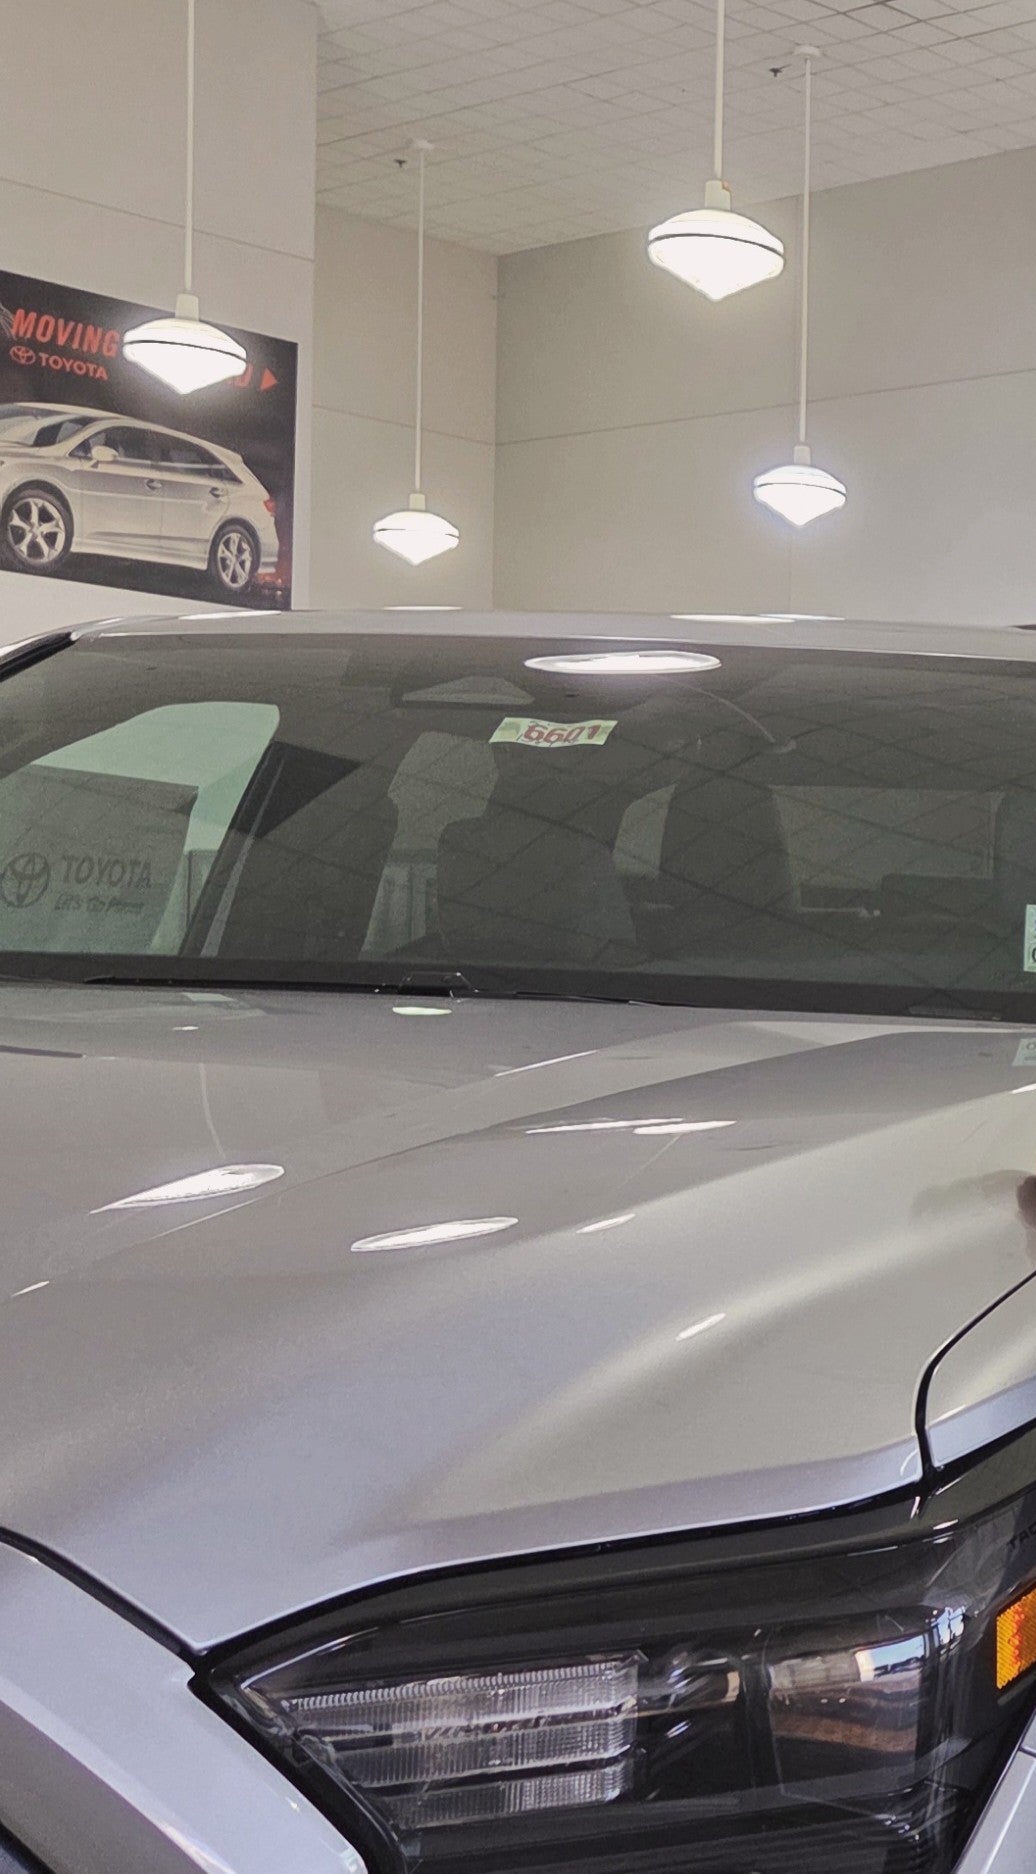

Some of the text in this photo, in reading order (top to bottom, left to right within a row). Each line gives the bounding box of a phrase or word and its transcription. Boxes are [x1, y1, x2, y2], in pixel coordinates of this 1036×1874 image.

[12, 309, 119, 357] MOVING
[40, 353, 109, 381] TOYOTA
[62, 856, 151, 889] TOYOTA
